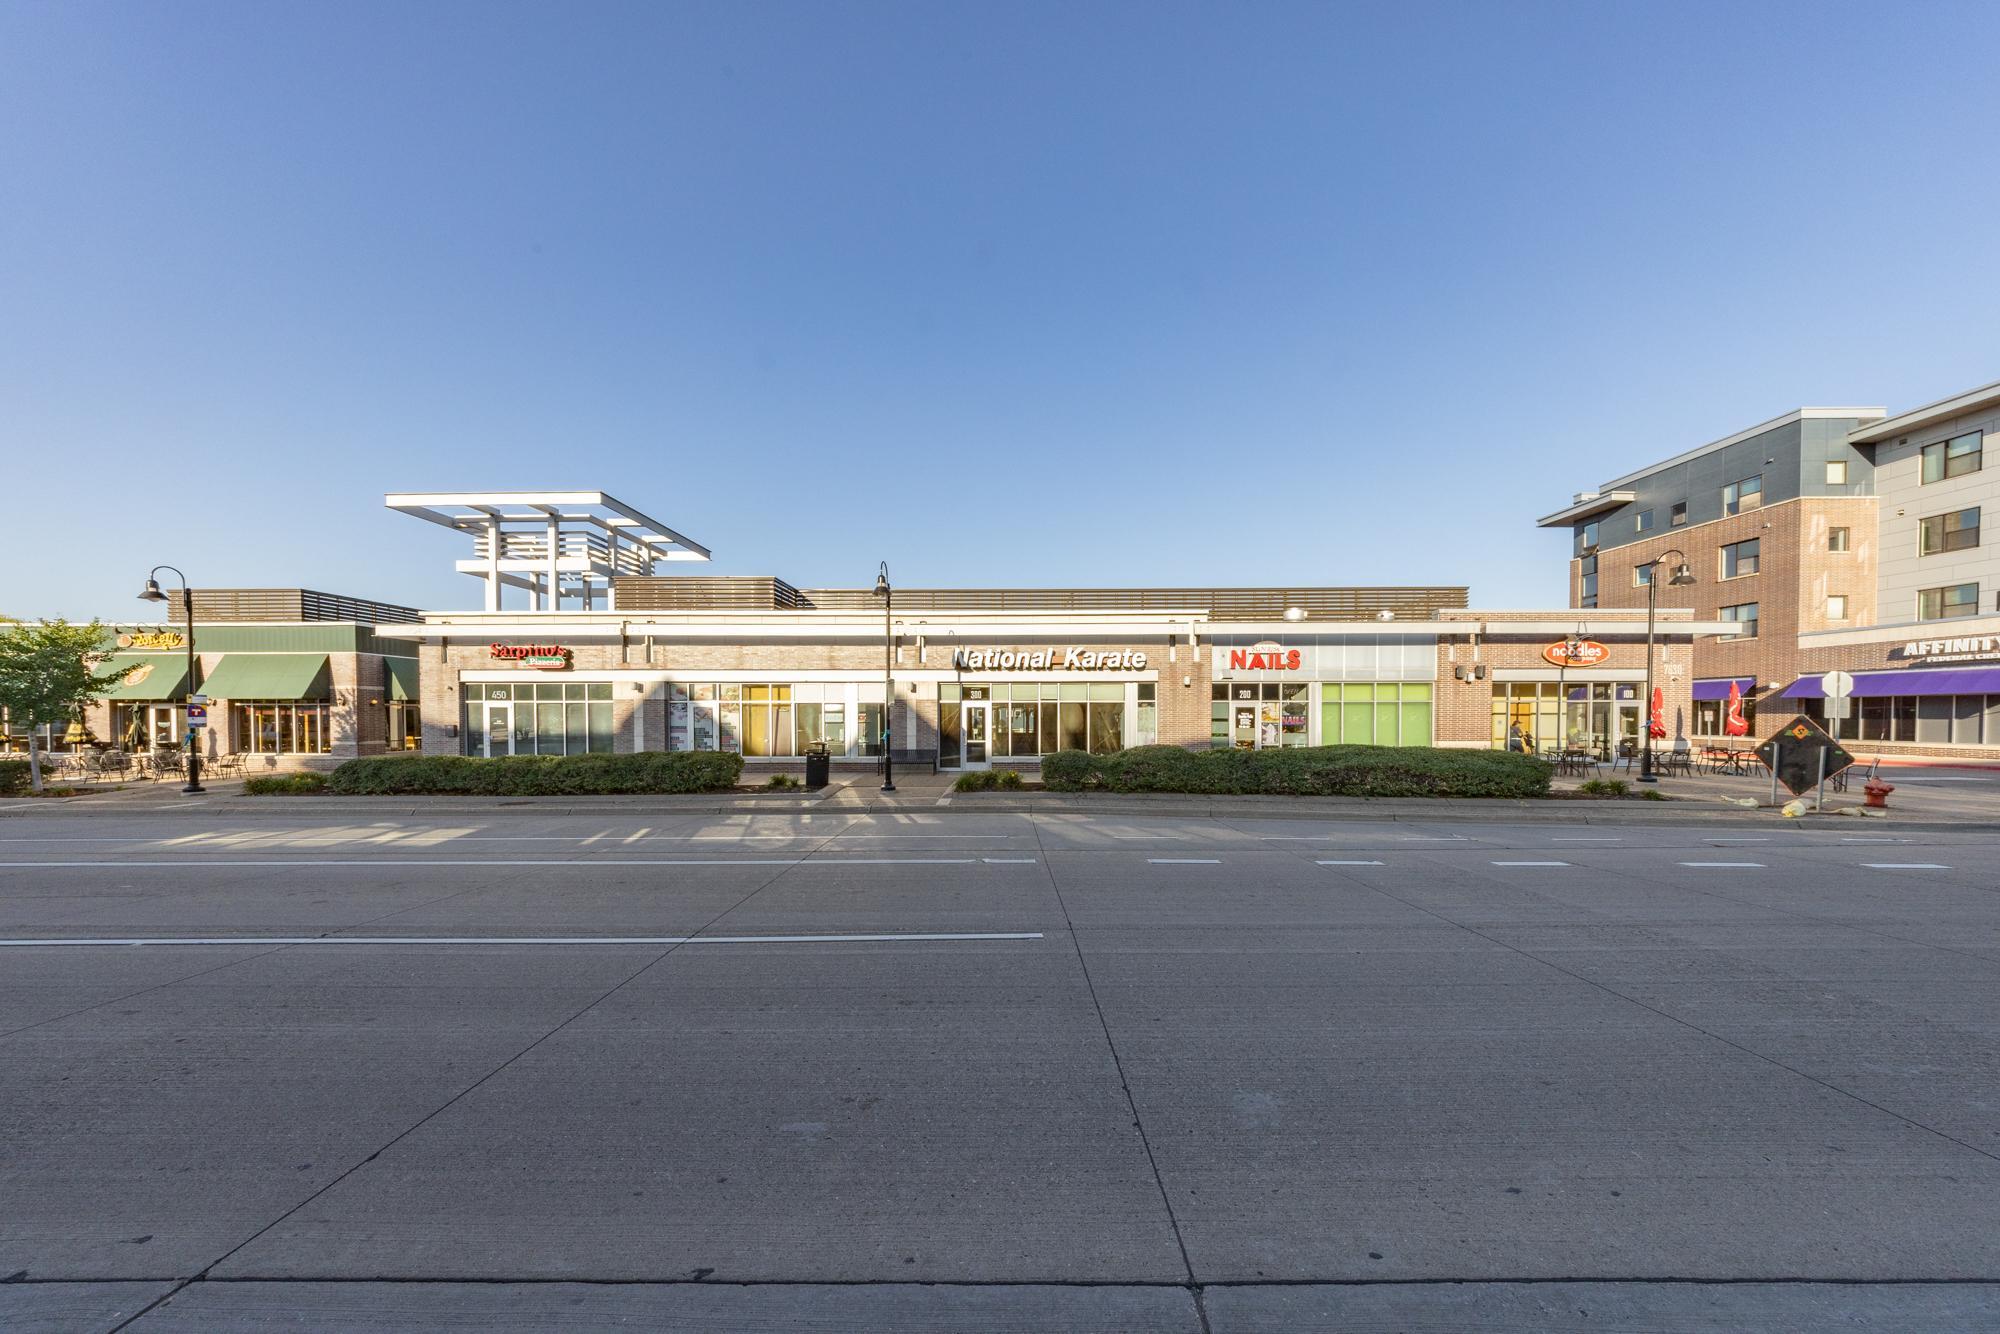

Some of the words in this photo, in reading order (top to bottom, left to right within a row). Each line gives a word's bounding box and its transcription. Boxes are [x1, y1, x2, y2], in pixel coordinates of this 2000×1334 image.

[490, 642, 566, 660] Sarpino's
[1552, 643, 1602, 657] noodles
[954, 646, 1053, 670] National
[1063, 647, 1147, 670] Karate
[1230, 649, 1301, 670] NAILS
[491, 690, 507, 699] 450
[1623, 689, 1634, 699] 100
[1281, 715, 1305, 726] NAILS
